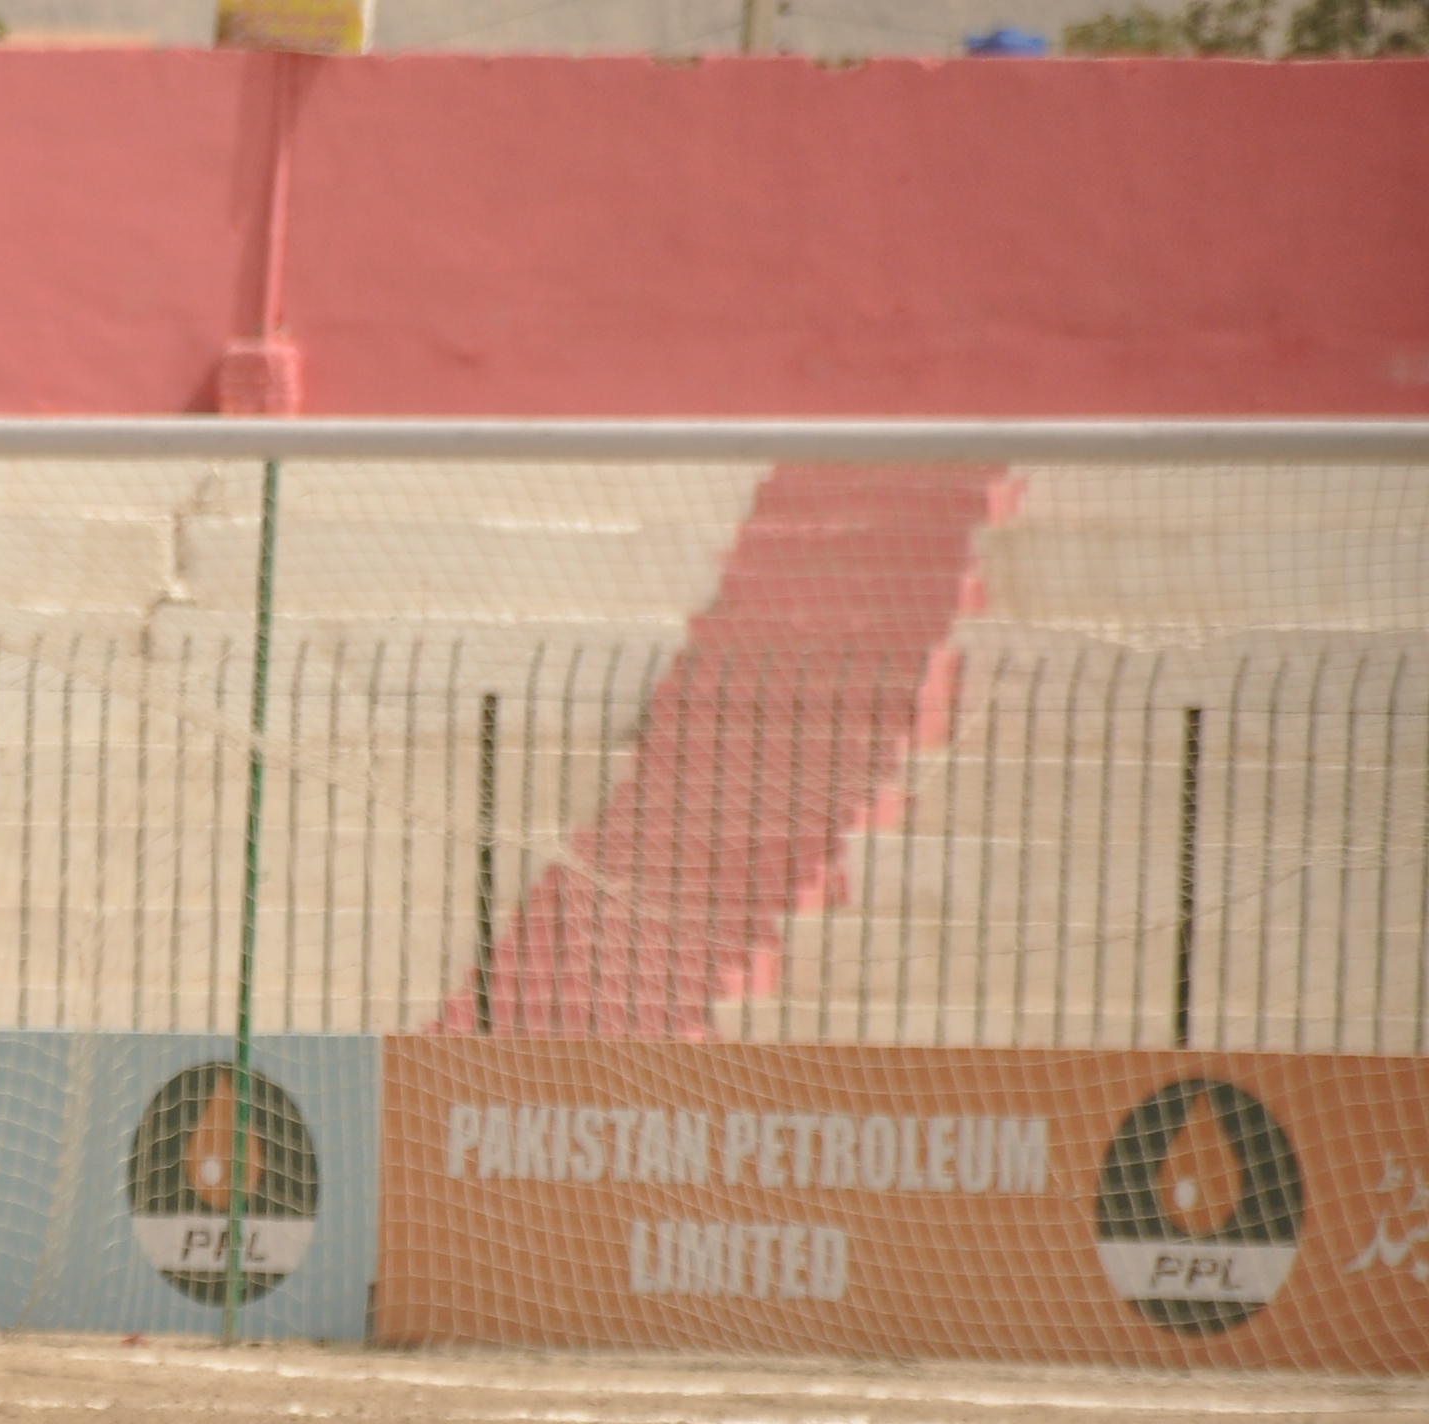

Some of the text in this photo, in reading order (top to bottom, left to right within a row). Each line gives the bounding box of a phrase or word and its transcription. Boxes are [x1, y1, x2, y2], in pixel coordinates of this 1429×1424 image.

[447, 1103, 1049, 1196] PAKISTAN PETROLEUM
[180, 1228, 268, 1265] PPL
[628, 1219, 850, 1302] LIMITED
[1149, 1253, 1243, 1293] PPL
